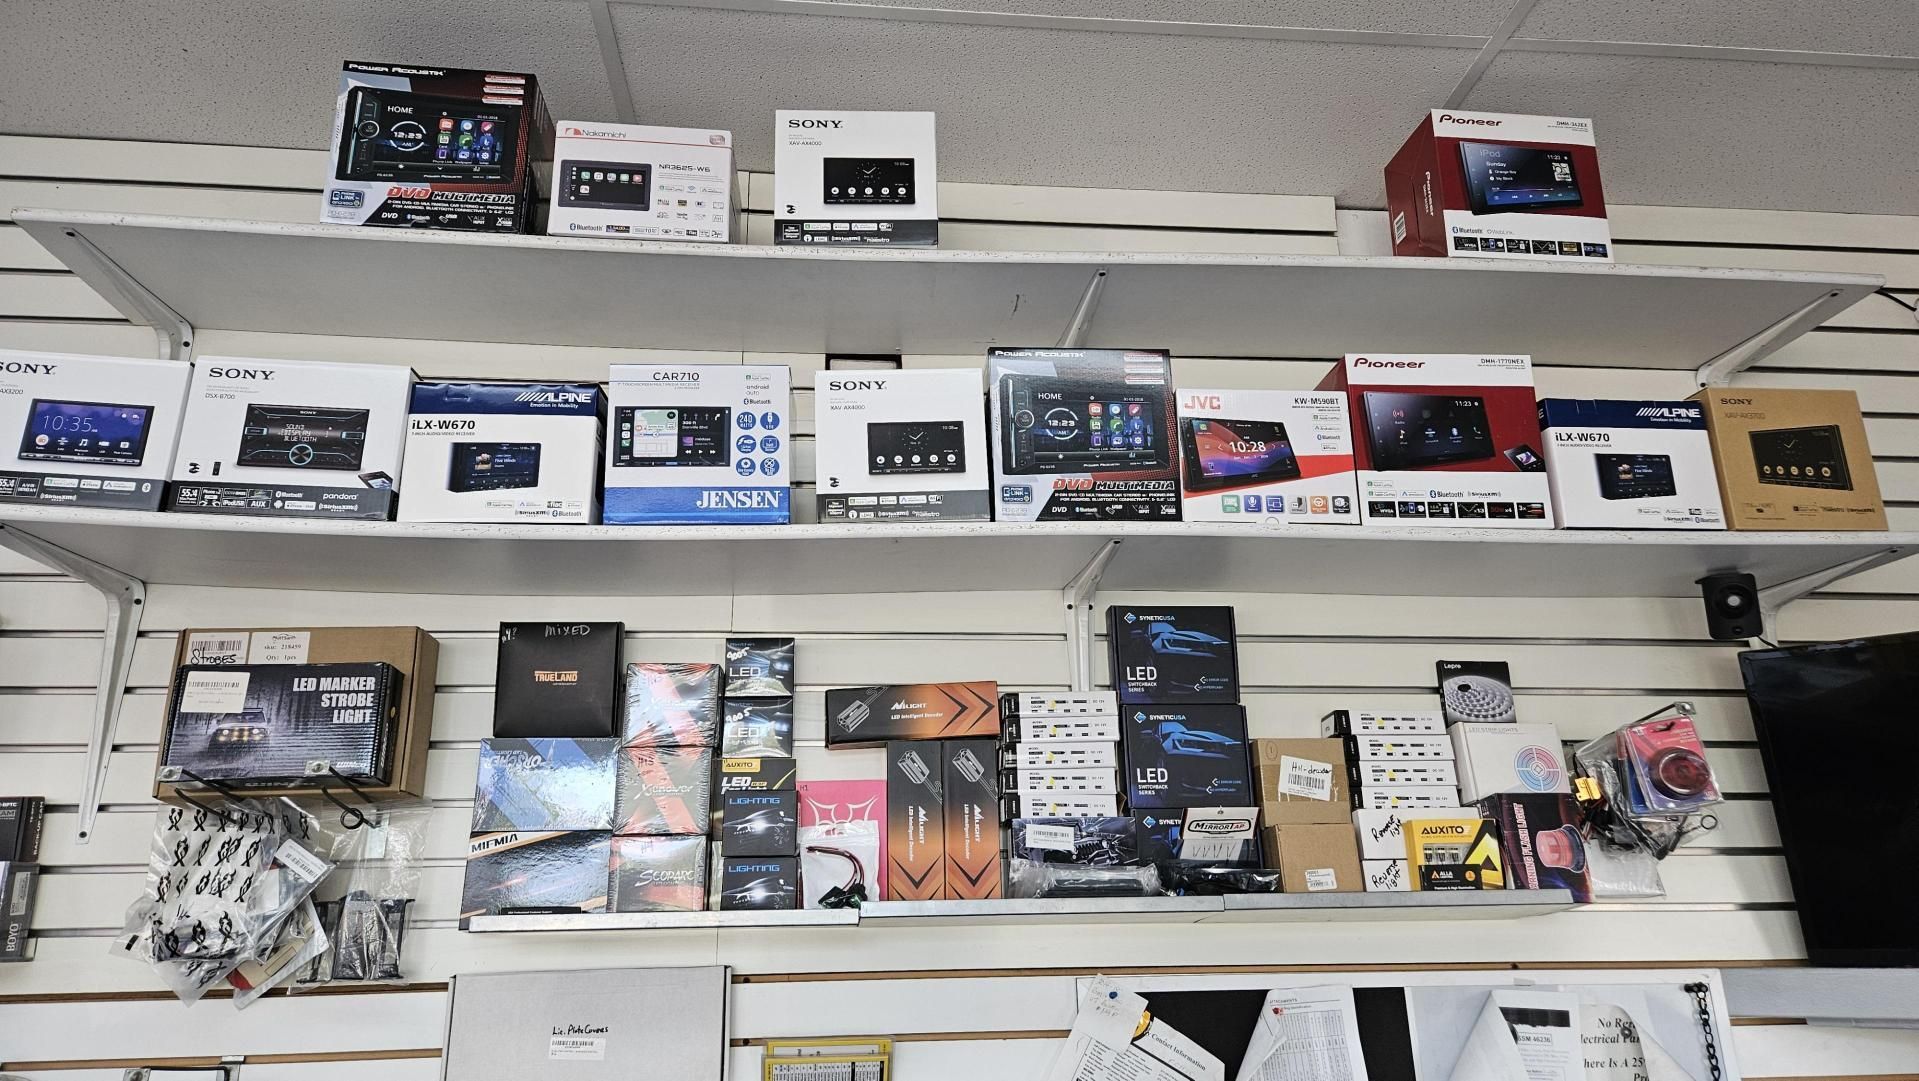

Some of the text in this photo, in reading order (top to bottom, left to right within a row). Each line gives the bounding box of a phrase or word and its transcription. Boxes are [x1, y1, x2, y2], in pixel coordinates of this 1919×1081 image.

[388, 106, 413, 114] HOME
[788, 119, 842, 129] SONY
[1439, 114, 1502, 127] Pioneer
[394, 131, 422, 139] 12:23
[582, 129, 626, 138] Nakamichi
[387, 187, 515, 204] DVD MULTIMEDIA
[577, 224, 603, 232] Bluetooth
[0, 362, 57, 375] ONY
[1354, 358, 1425, 369] Pioneer
[209, 368, 275, 380] SONY
[653, 372, 700, 381] CAR710
[830, 381, 887, 390] SONY
[1184, 396, 1220, 410] JVC
[1720, 398, 1752, 406] SONY
[43, 415, 92, 432] 10:35
[739, 415, 752, 423] 240
[412, 420, 475, 429] iLX-W670
[1555, 433, 1610, 443] iLX-W670
[1229, 441, 1266, 453] 10:28
[1052, 478, 1175, 490] DVD MULTIMEDIA
[696, 491, 780, 508] JENSEN
[534, 671, 578, 682] TRUELAND
[730, 667, 760, 676] LED
[1127, 666, 1157, 680] LED
[293, 677, 375, 692] LED MARKER
[321, 693, 374, 707] STROBE
[332, 709, 371, 723] LIGHT
[728, 728, 759, 737] LED
[1137, 768, 1168, 782] LED
[722, 777, 751, 786] LED
[1421, 826, 1464, 835] AUXITO
[6, 923, 19, 951] BOYO
[1598, 1018, 1611, 1028] No
[1580, 1034, 1620, 1043] lectrical
[1151, 1033, 1173, 1050] Contact
[1173, 1047, 1206, 1070] Information
[1584, 1058, 1605, 1068] here
[1609, 1058, 1618, 1068] Is
[1621, 1059, 1629, 1068] A
